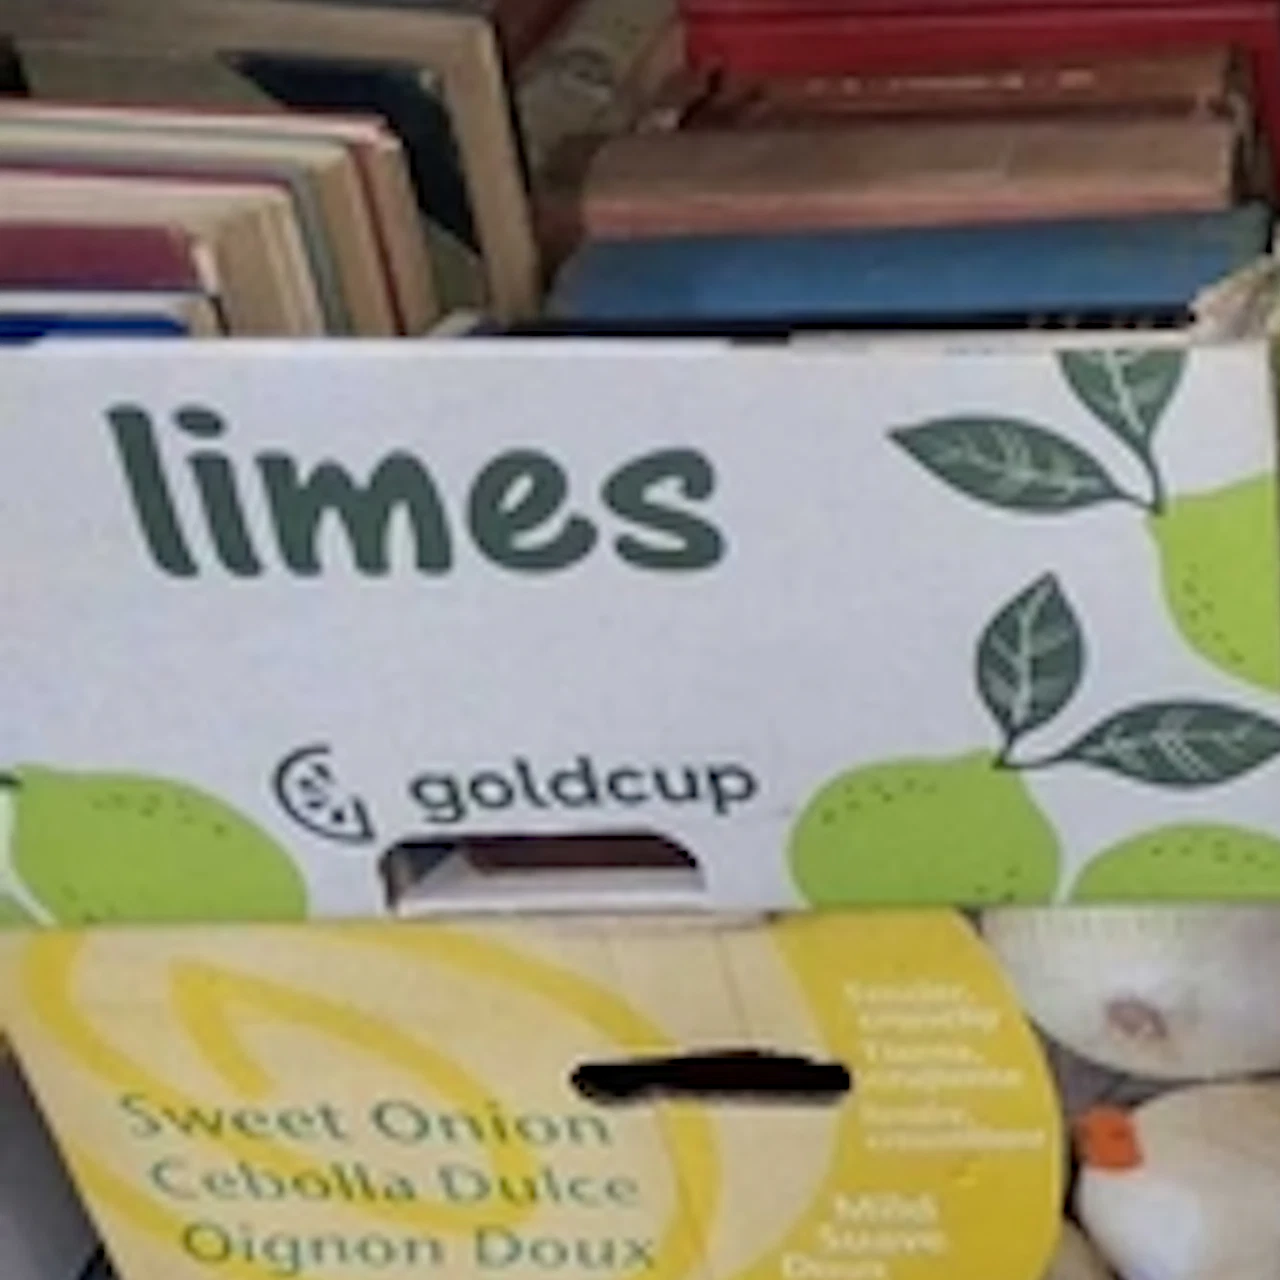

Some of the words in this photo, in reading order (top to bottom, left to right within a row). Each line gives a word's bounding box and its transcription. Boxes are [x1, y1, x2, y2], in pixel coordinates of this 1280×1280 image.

[105, 403, 726, 577] limes
[408, 754, 758, 824] goldcup
[119, 1093, 347, 1140] Sweet
[371, 1098, 613, 1146] Onion
[150, 1155, 416, 1202] Cebolla
[438, 1165, 640, 1207] Dulce
[182, 1221, 446, 1276] Oignon
[475, 1227, 657, 1270] Doux
